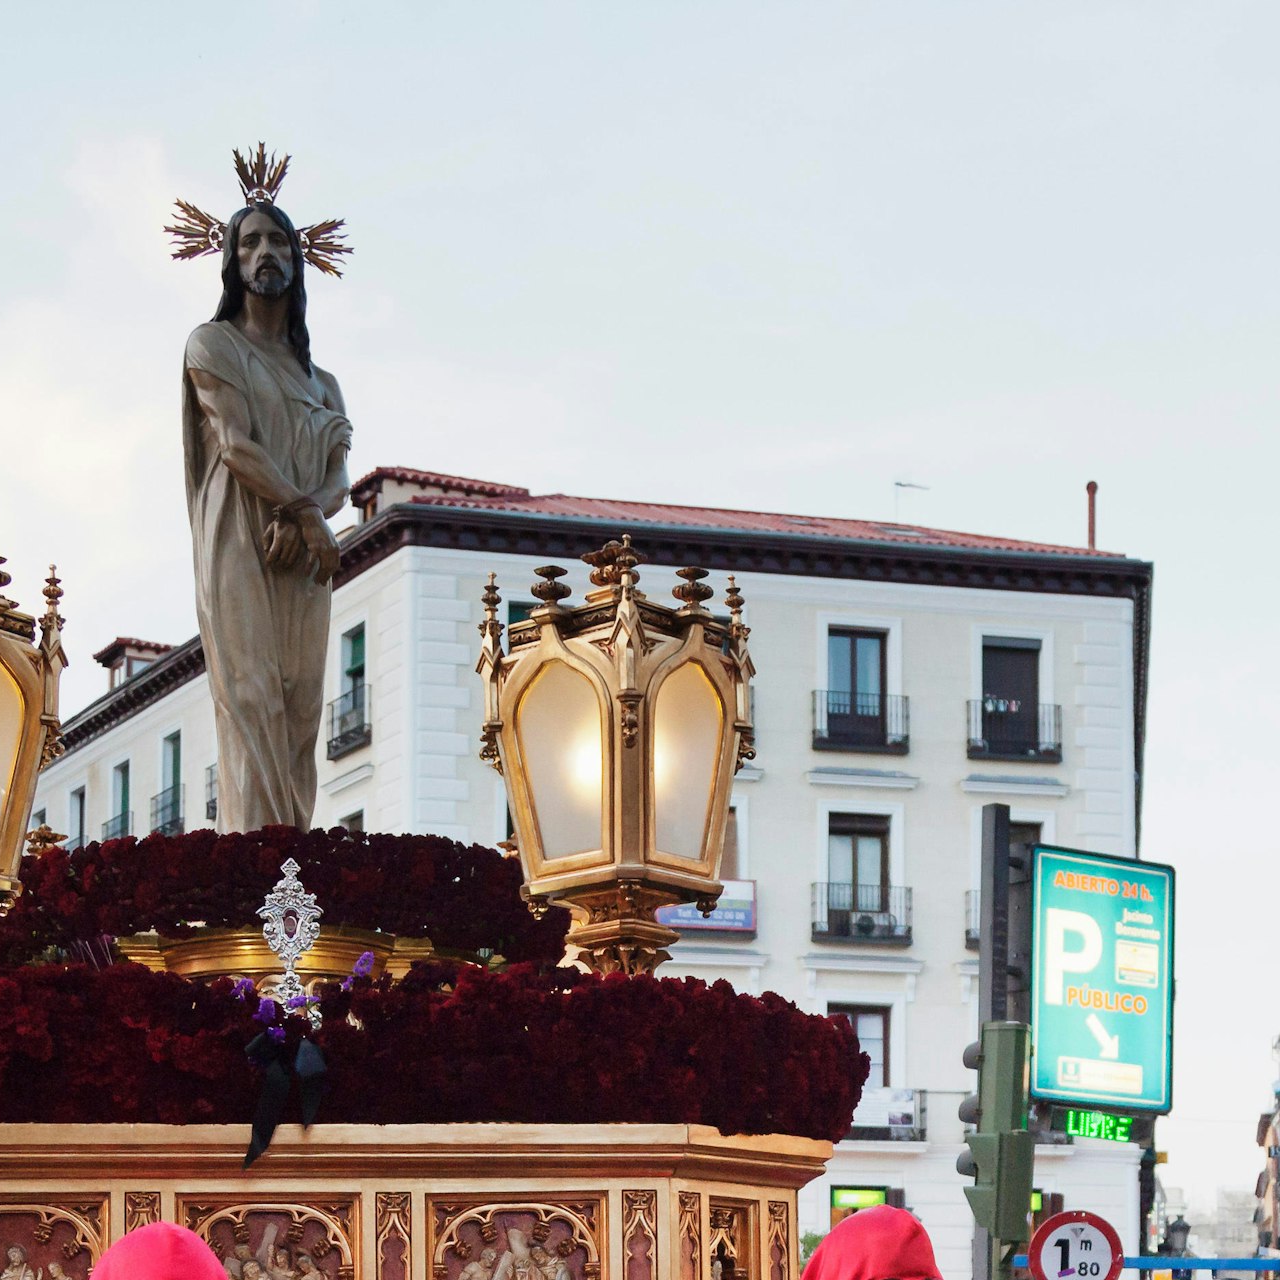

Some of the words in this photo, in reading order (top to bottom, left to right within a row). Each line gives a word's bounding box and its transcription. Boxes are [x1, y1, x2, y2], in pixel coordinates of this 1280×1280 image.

[1054, 870, 1119, 896] ABIERTO
[1122, 881, 1138, 898] 24
[1044, 907, 1103, 1006] P
[1067, 983, 1148, 1016] PÚBLICO
[1053, 1238, 1070, 1273] 1
[1080, 1239, 1093, 1251] m
[1078, 1261, 1100, 1277] 80
